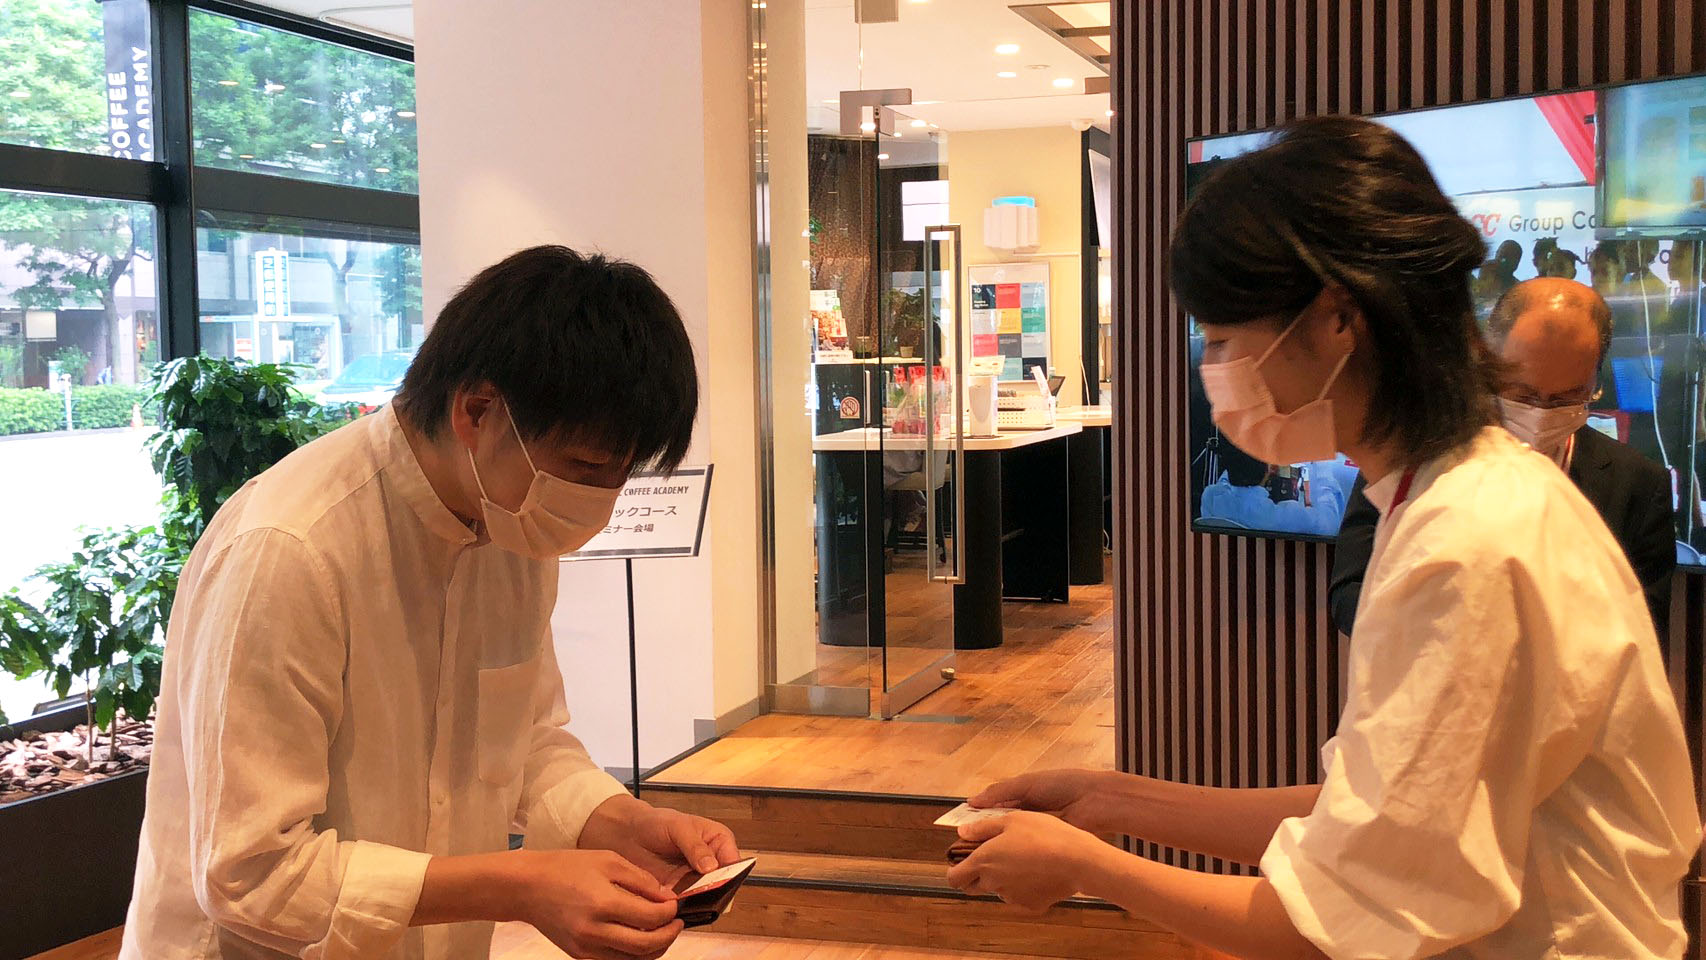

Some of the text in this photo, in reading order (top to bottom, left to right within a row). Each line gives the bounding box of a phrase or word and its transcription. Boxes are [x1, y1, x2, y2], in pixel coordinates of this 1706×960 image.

[107, 71, 132, 160] COFFEE
[1508, 214, 1564, 235] Group
[624, 487, 652, 496] COFFEE
[653, 485, 690, 496] ACADEMY
[615, 505, 678, 518] ックコース
[599, 523, 655, 534] ミナー会場
